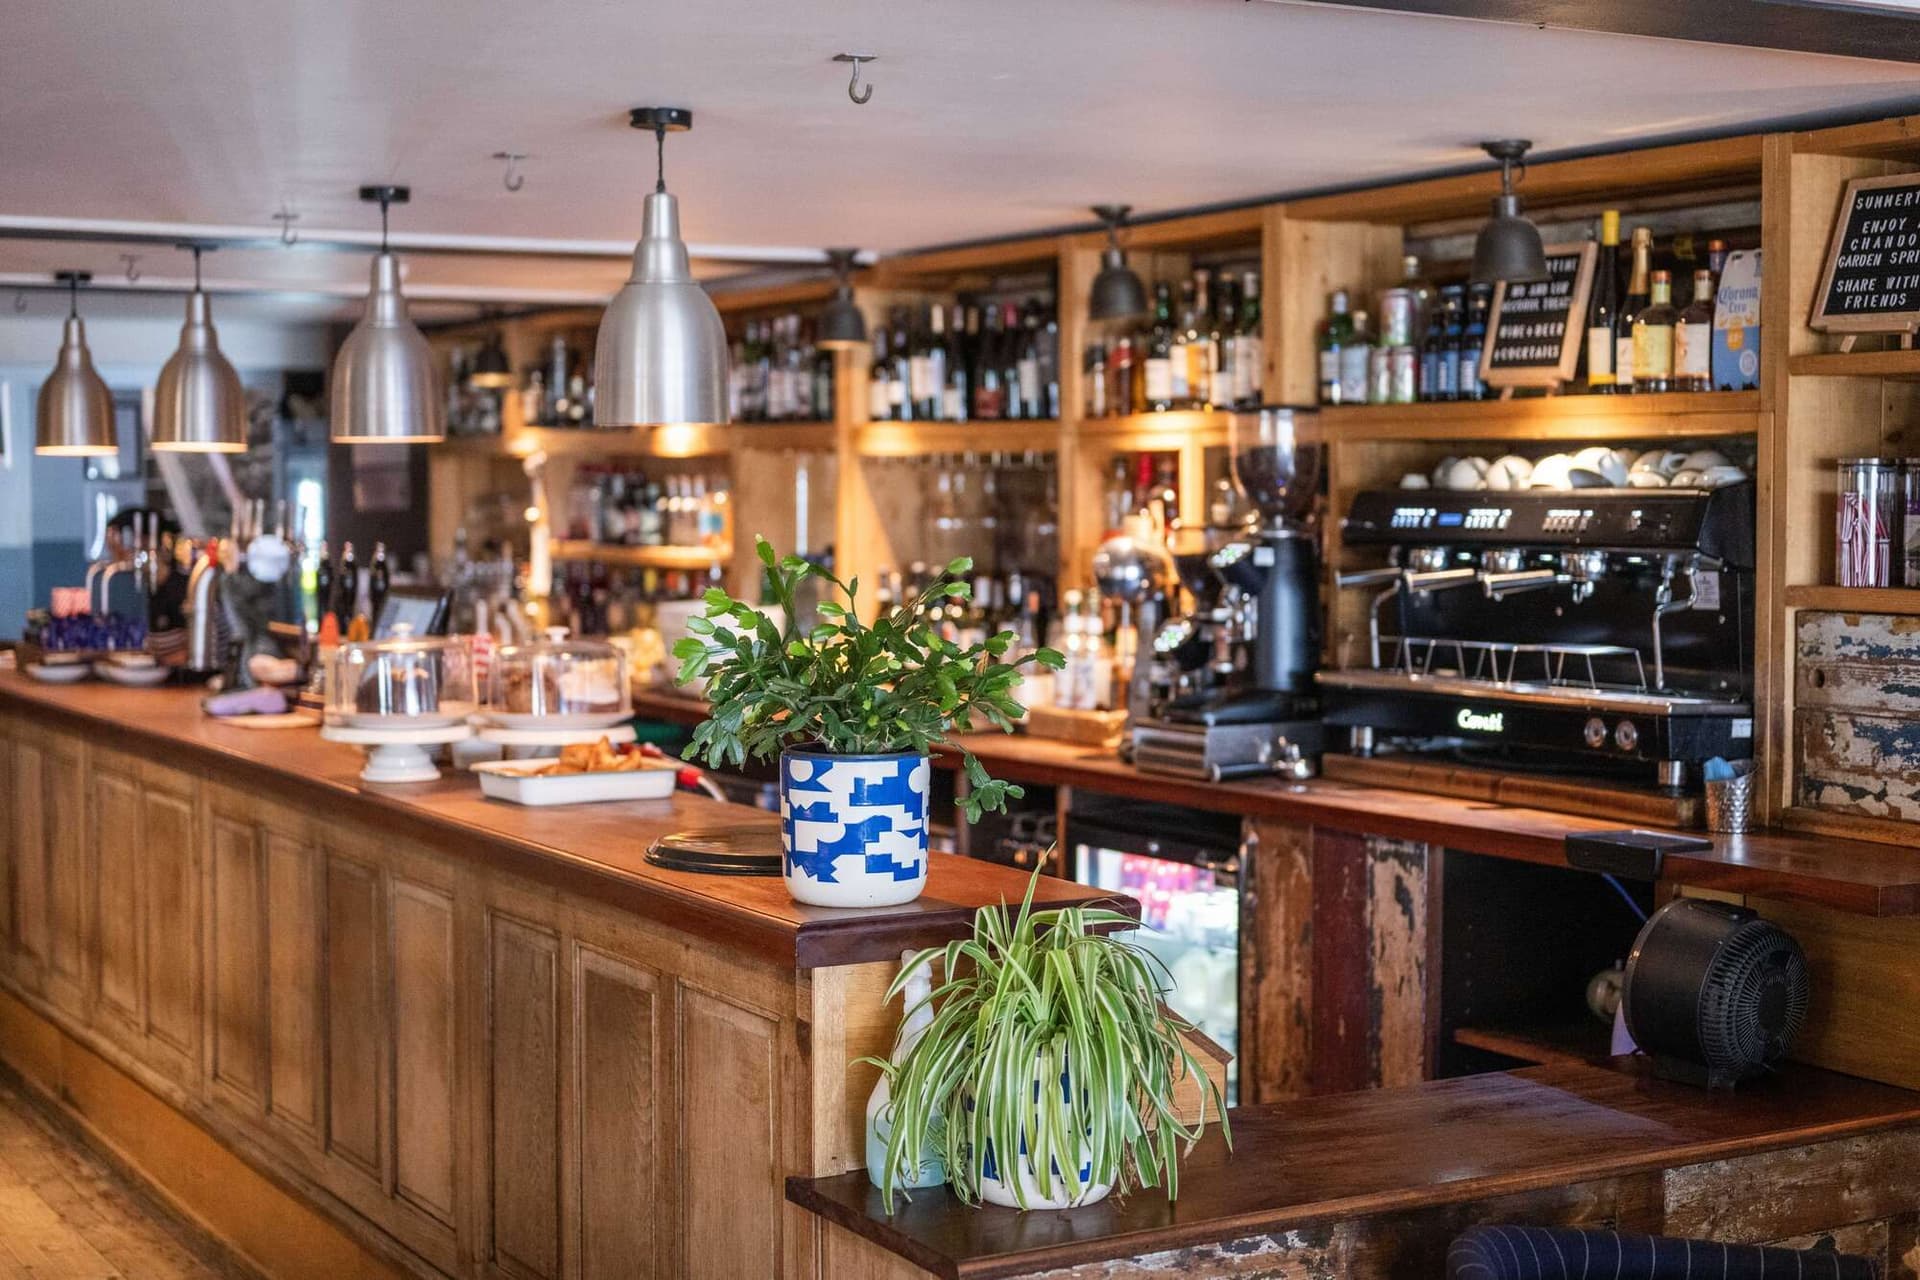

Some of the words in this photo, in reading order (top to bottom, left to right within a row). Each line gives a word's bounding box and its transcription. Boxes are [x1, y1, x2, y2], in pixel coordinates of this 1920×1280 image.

[1862, 217, 1907, 234] ENJOY
[1850, 233, 1917, 251] CHANDO
[1838, 253, 1882, 268] GARDEN
[1836, 278, 1877, 293] SHARE
[1886, 274, 1920, 290] WITH
[1719, 285, 1759, 306] Corona
[1844, 292, 1907, 309] FRIENDS
